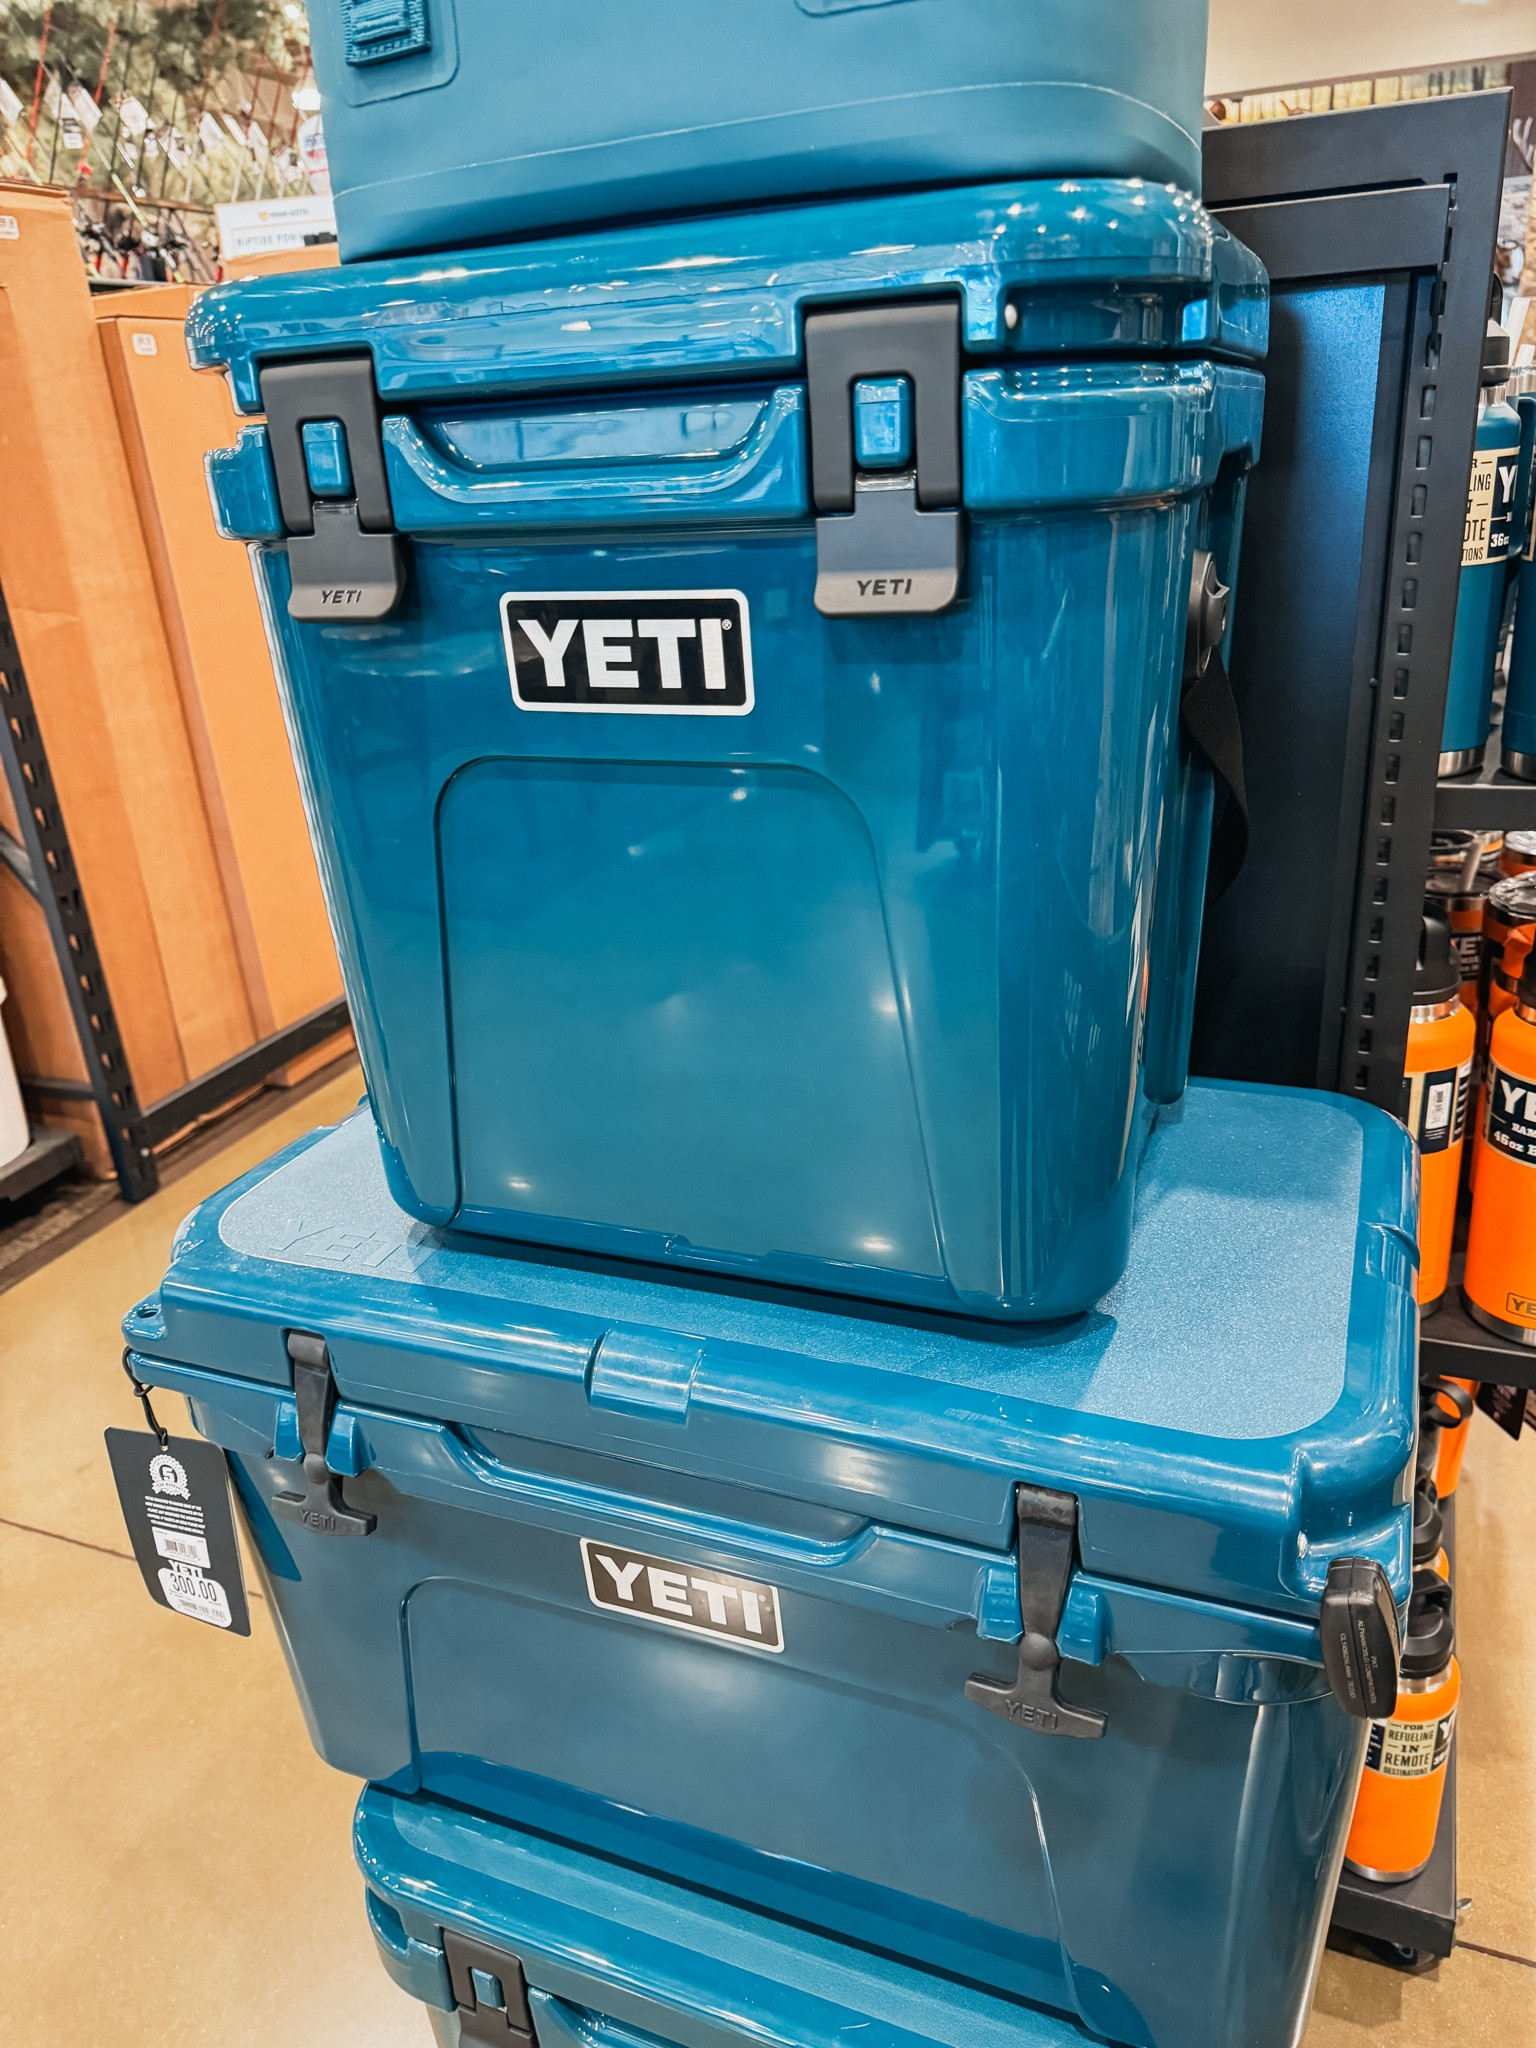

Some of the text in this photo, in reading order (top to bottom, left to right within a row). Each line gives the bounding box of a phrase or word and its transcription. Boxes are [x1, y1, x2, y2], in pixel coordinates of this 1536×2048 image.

[857, 578, 912, 596] YETI
[321, 589, 362, 604] YETI
[1494, 1130, 1525, 1153] 46oz
[269, 1219, 446, 1274] YETI
[299, 1509, 336, 1531] YETI
[170, 1573, 217, 1602] 300.00
[1005, 1699, 1058, 1729] YETI
[1388, 1730, 1435, 1743] REFUELING
[1401, 1744, 1420, 1753] IN
[1384, 1752, 1431, 1767] REMOTE
[1383, 1765, 1428, 1777] DESTINATIONS
